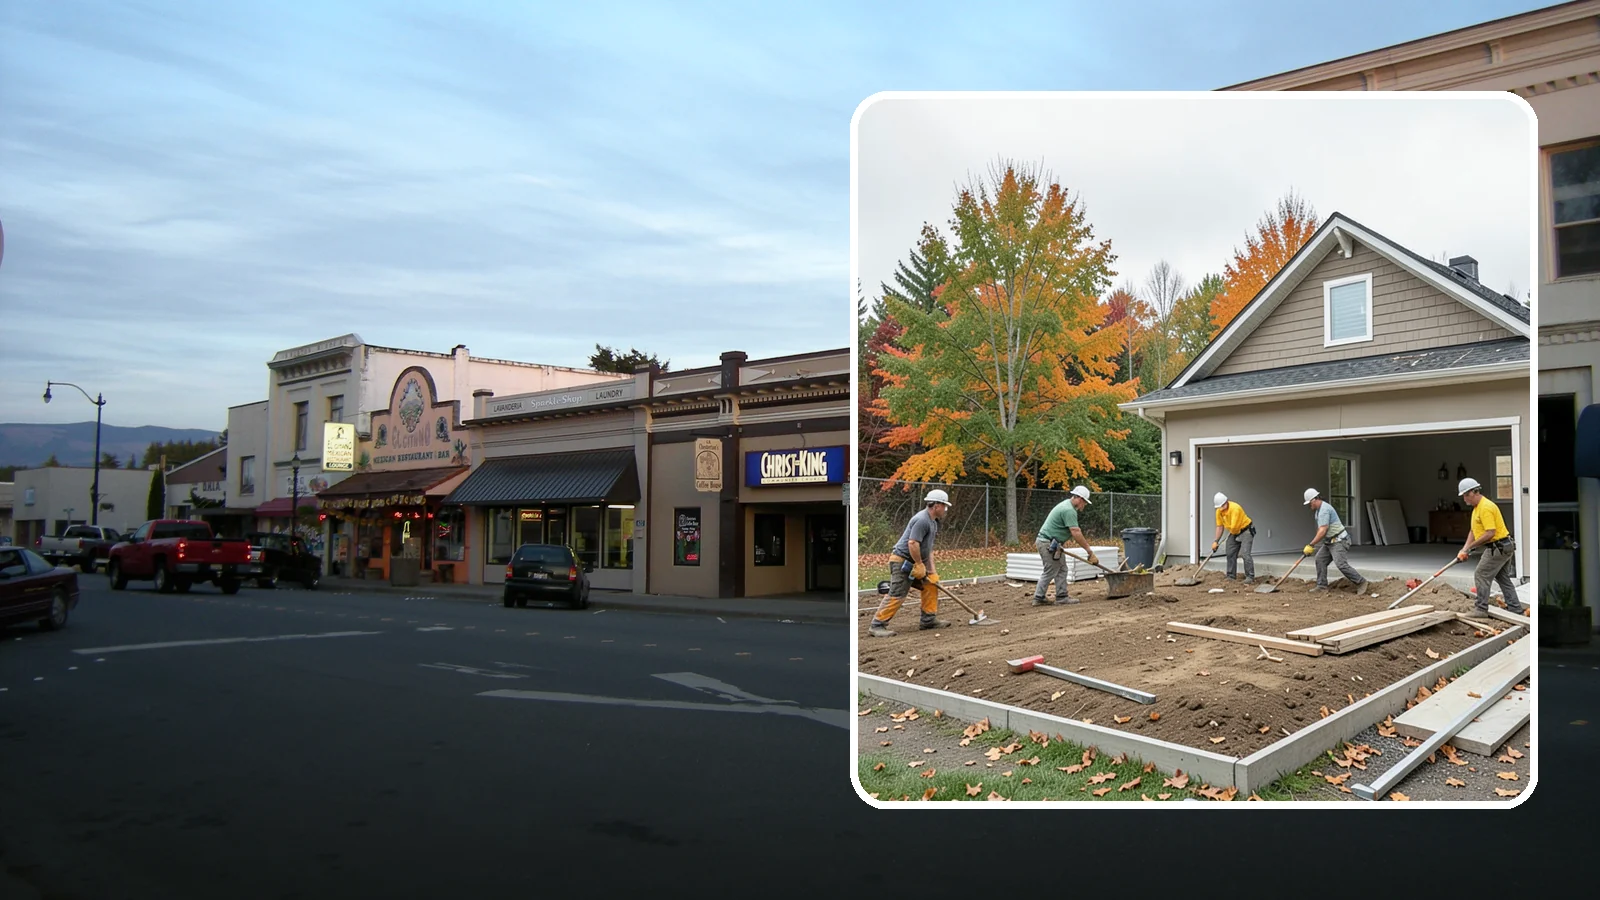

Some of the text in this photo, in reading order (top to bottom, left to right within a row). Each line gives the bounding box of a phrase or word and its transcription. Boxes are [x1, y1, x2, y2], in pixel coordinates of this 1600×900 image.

[493, 402, 523, 413] LAVANDERIA
[562, 394, 582, 404] Shop
[595, 389, 623, 400] LAUNDRY
[373, 450, 450, 464] MEXICAN RESTAURANT BAR
[761, 449, 827, 478] CHRIST KING
[696, 480, 709, 488] Coffee
